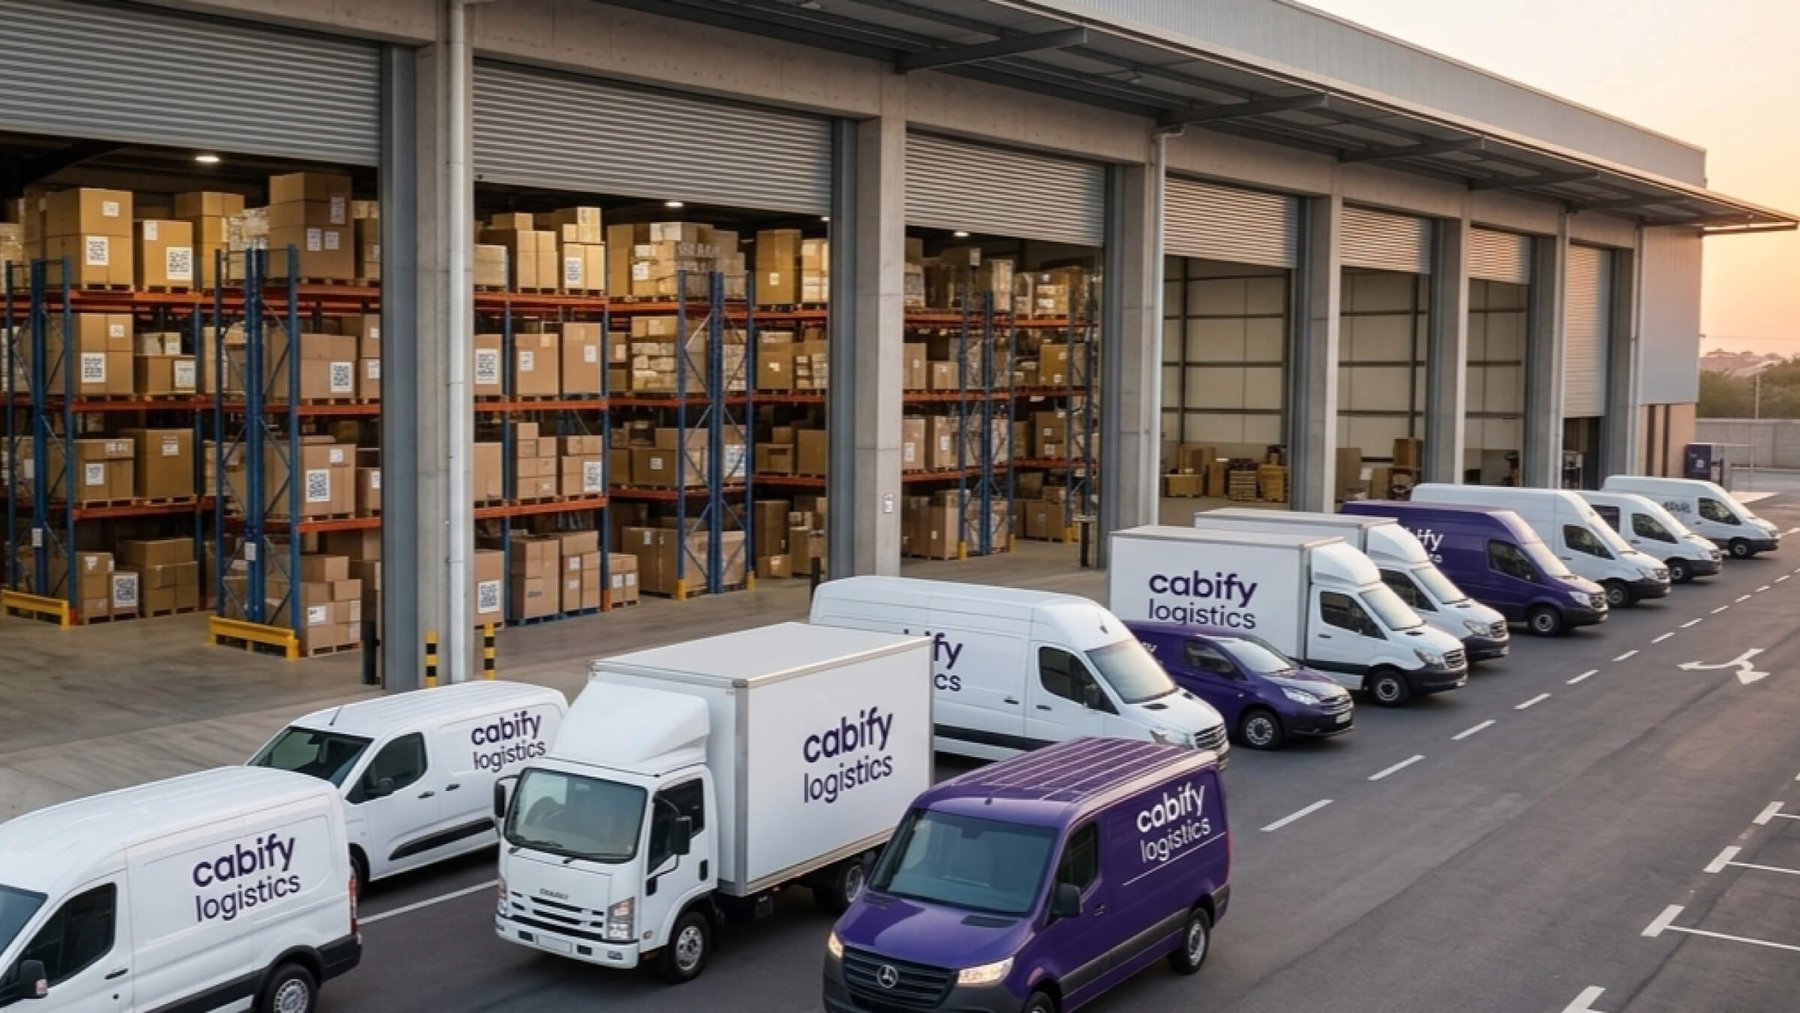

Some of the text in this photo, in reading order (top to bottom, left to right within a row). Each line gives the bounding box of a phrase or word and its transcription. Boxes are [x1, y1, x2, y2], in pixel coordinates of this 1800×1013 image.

[1149, 570, 1258, 608] cabify
[1148, 598, 1256, 629] logistics
[471, 710, 541, 746] cabify
[803, 706, 893, 763] cabify
[473, 740, 546, 773] logistics
[804, 755, 893, 804] logistics
[1136, 782, 1205, 833] cabify
[193, 833, 295, 888] cabify
[1140, 818, 1211, 863] logistics
[196, 875, 301, 922] logistics
